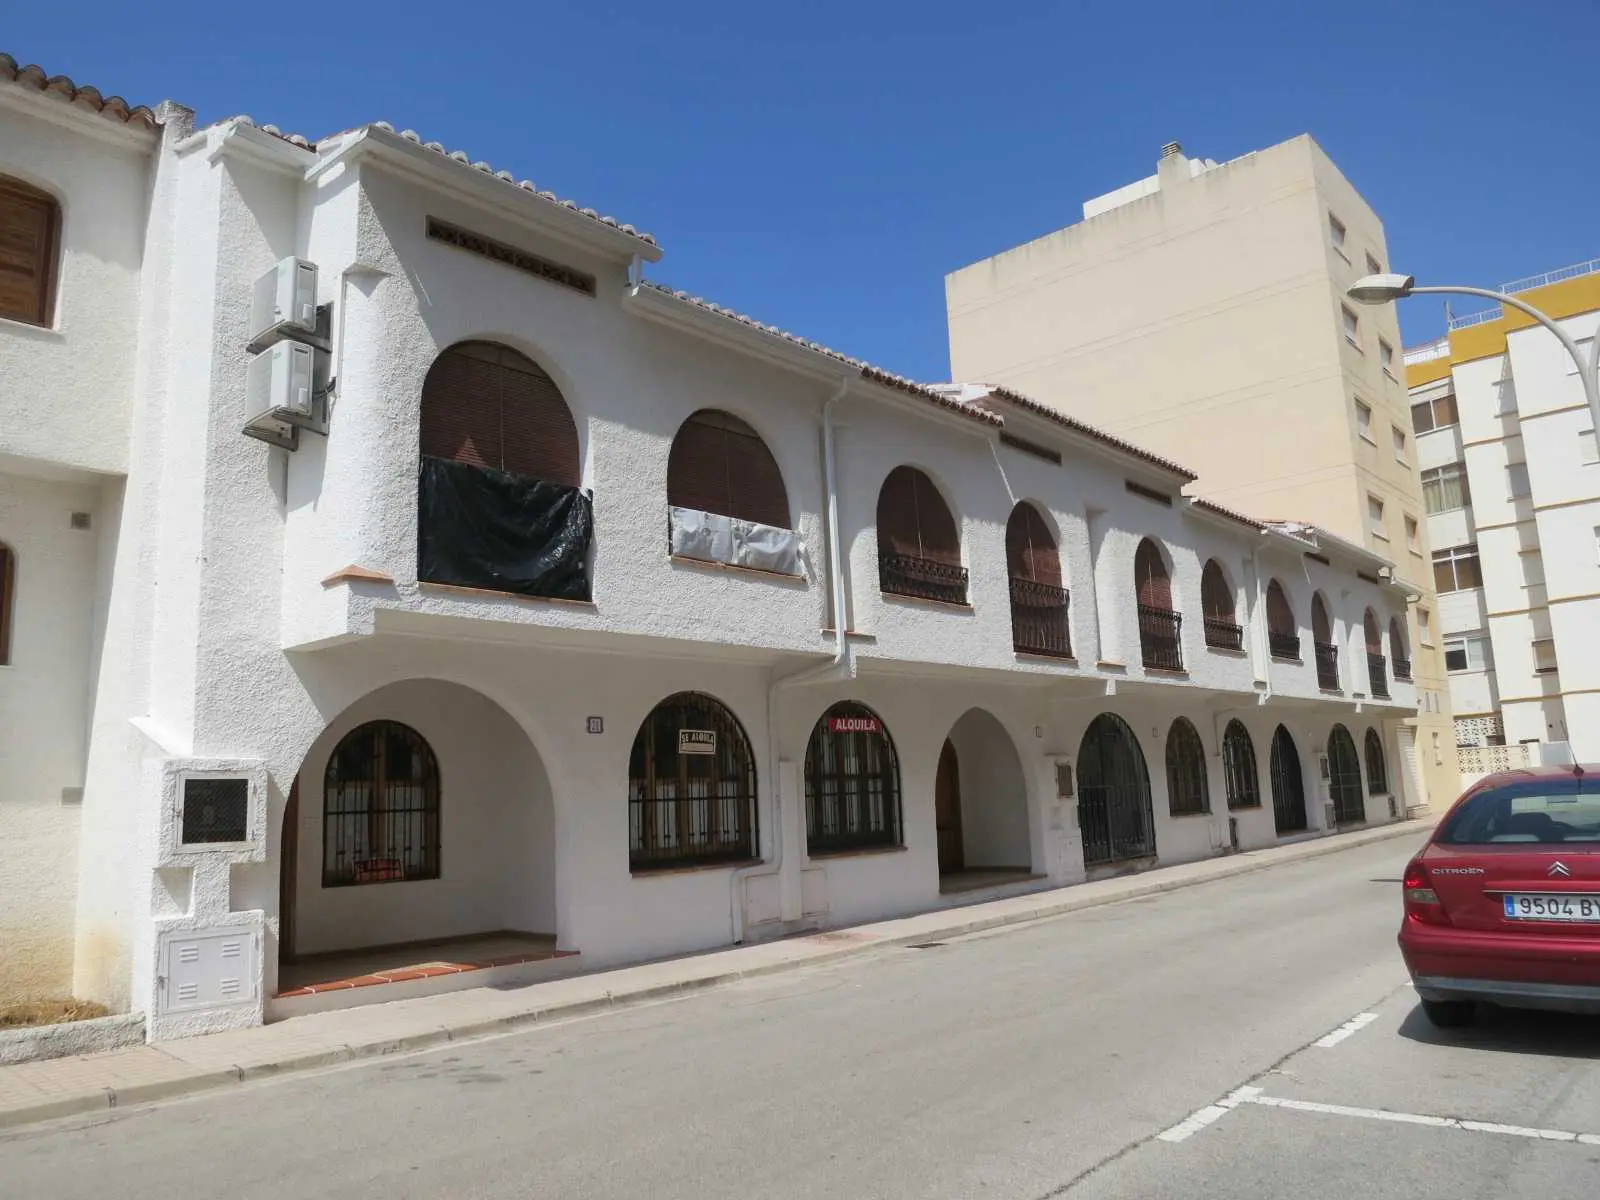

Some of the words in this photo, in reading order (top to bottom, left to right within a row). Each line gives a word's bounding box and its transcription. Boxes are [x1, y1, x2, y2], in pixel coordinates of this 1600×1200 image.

[836, 718, 876, 730] ALQUILA
[681, 733, 689, 743] SE
[1520, 897, 1573, 915] 9504
